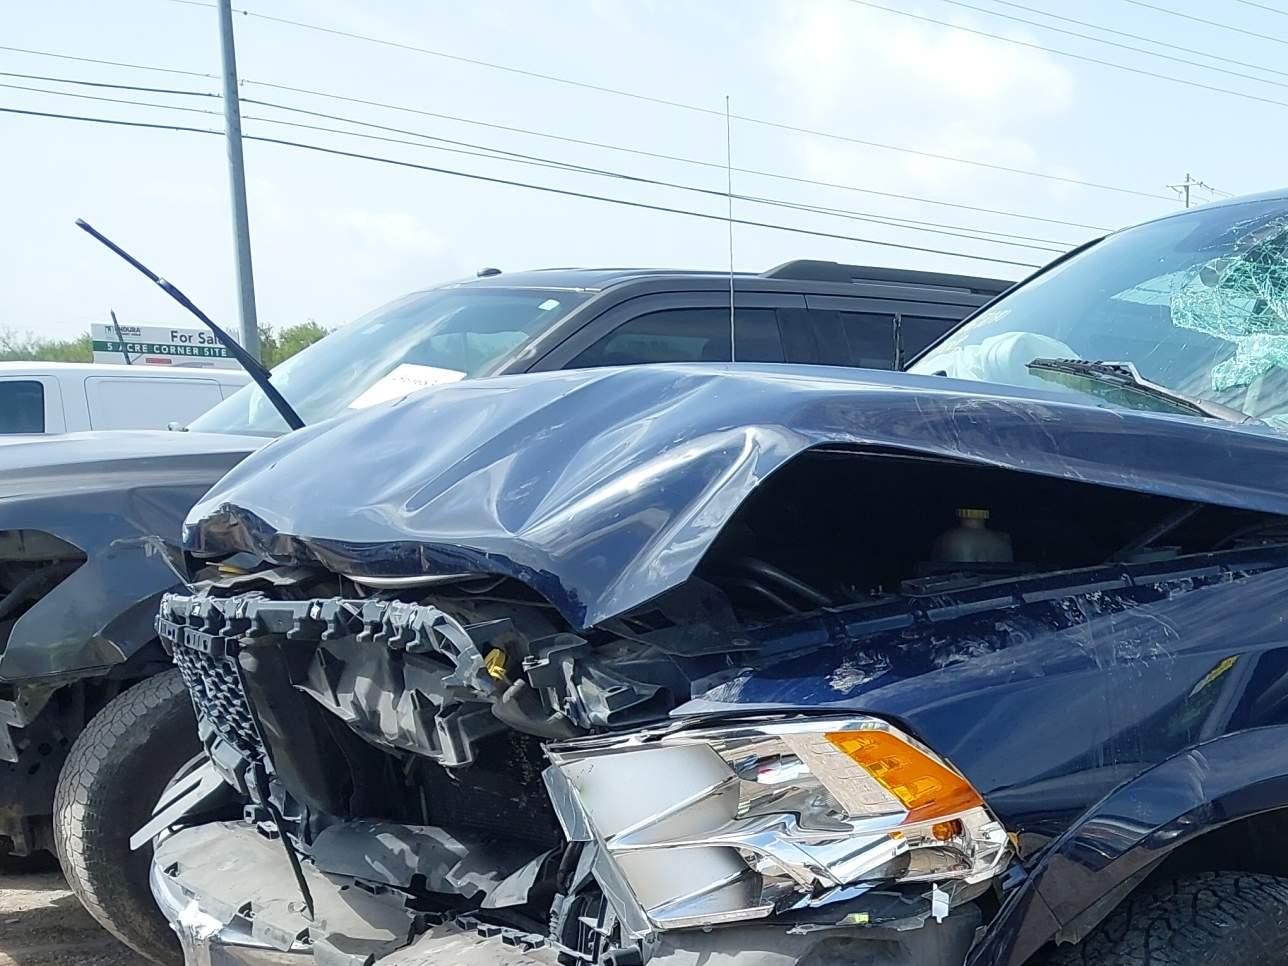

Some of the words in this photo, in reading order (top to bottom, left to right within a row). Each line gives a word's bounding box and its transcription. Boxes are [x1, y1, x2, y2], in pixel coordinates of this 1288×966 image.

[170, 327, 193, 344] For
[107, 343, 113, 351] 5
[153, 345, 200, 356] CORNER
[204, 347, 228, 357] SITE
